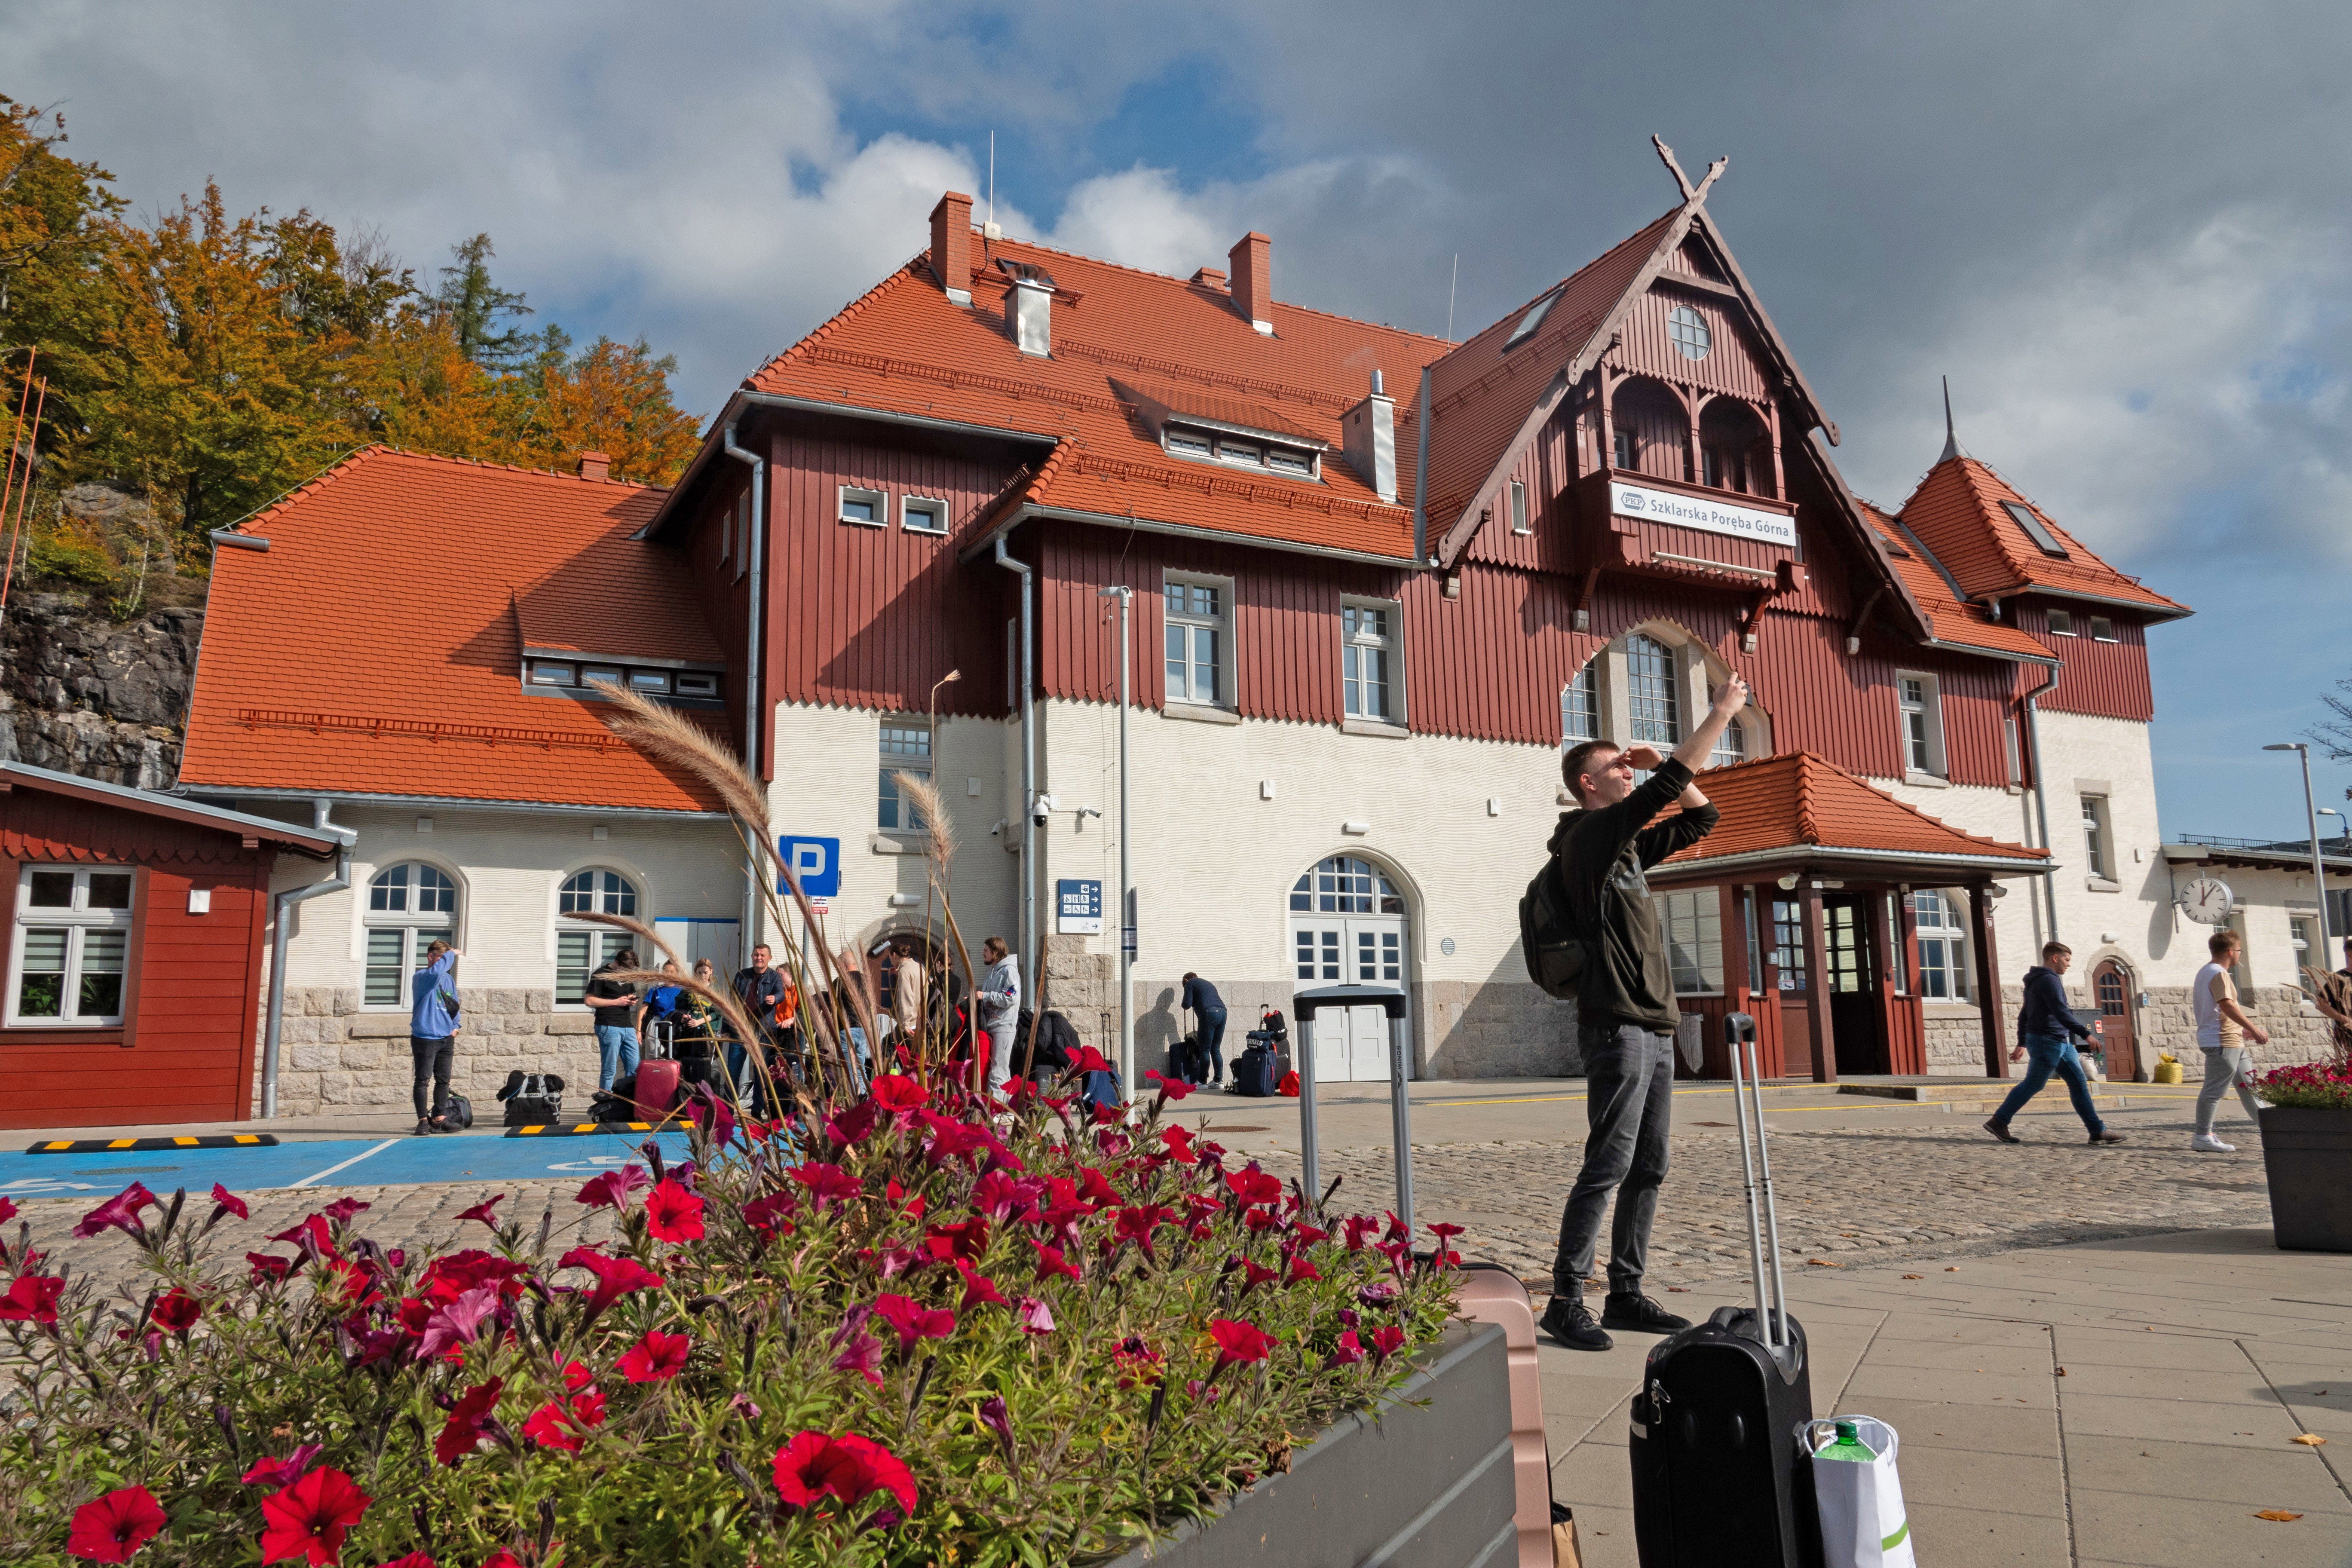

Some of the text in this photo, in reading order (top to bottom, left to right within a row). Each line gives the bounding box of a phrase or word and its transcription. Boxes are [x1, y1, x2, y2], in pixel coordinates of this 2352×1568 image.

[1625, 497, 1788, 536] PKP Szklarska Poręba Górna
[791, 843, 826, 887] P
